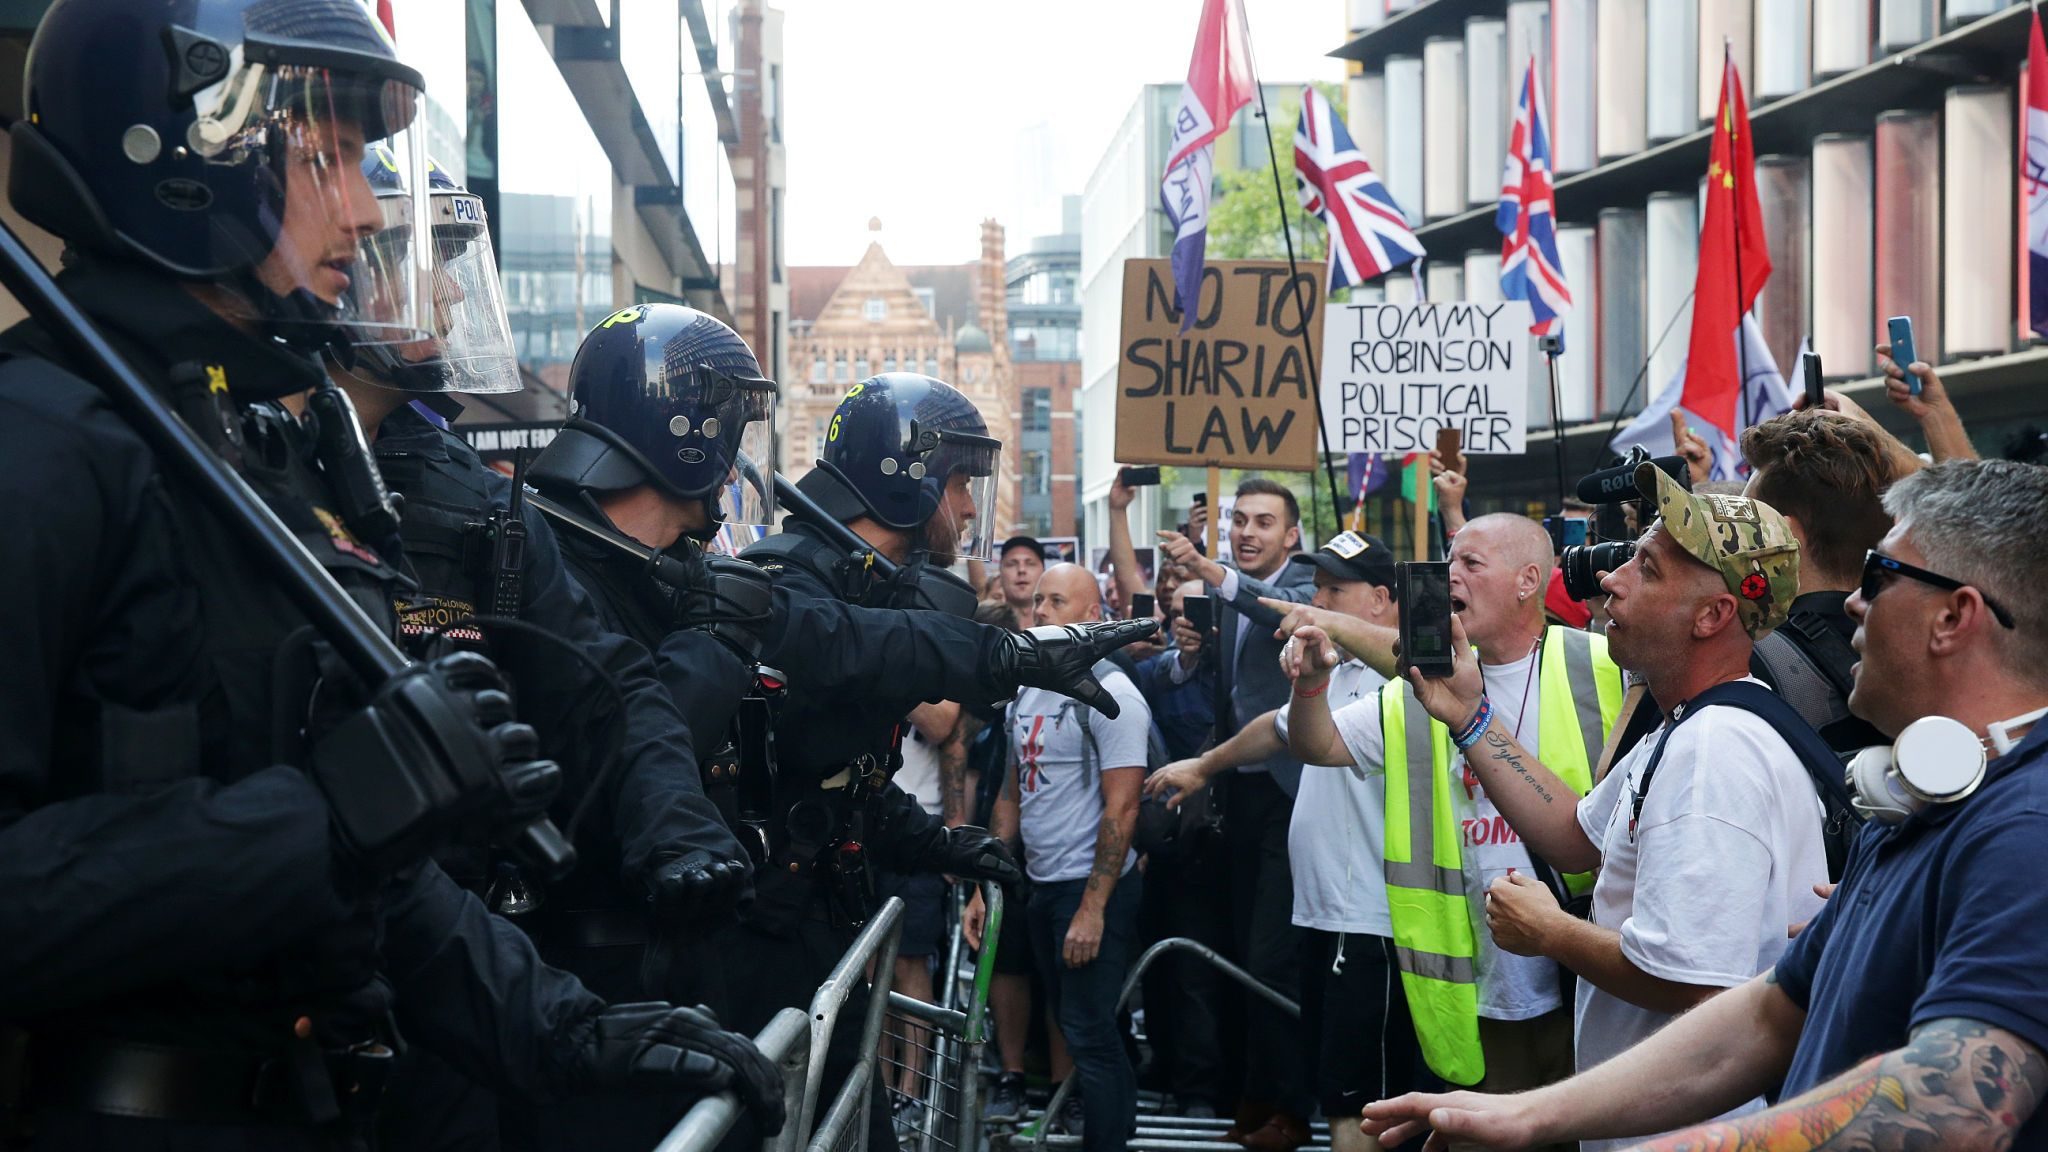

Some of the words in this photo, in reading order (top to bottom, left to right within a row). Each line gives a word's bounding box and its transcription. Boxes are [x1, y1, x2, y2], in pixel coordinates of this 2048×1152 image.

[1146, 266, 1223, 330] NO
[1233, 267, 1318, 337] TO
[1346, 304, 1505, 340] TOMMY
[1125, 338, 1307, 400] SHARIA
[1351, 340, 1512, 373] ROBINSON
[1342, 382, 1508, 415] POLITICAL
[476, 430, 499, 451] AM
[500, 429, 529, 450] NOT
[830, 414, 842, 442] 6
[1164, 401, 1296, 455] LAW
[1601, 471, 1634, 493] RØD
[1485, 730, 1528, 775] Tyler
[1461, 815, 1522, 848] TOM
